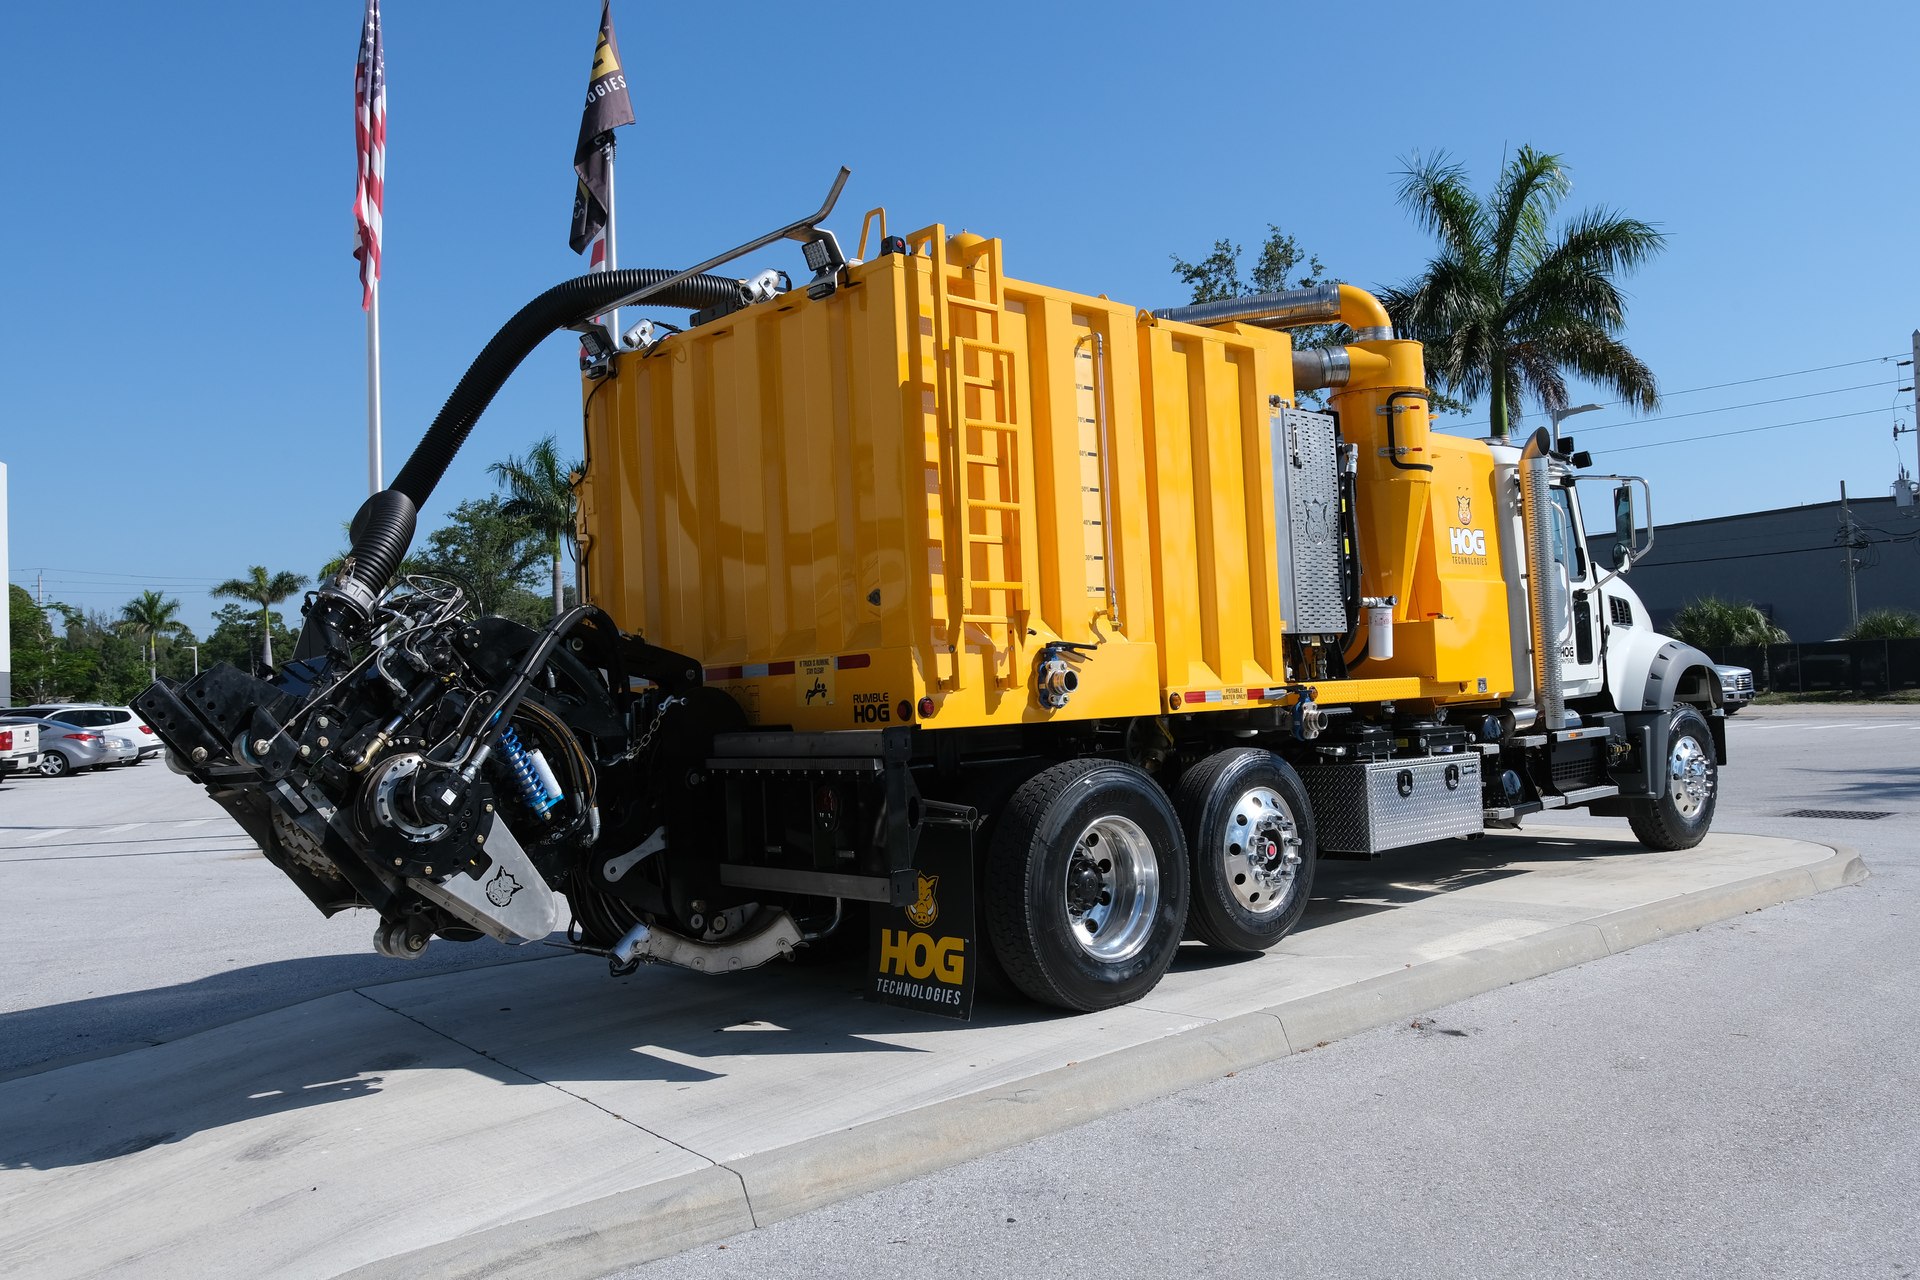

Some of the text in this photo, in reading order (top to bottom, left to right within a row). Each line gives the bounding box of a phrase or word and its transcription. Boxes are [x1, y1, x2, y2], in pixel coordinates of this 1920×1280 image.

[1449, 527, 1486, 556] HOG
[1452, 556, 1488, 566] TECHNOLOGIES
[1560, 646, 1574, 657] HOG
[853, 692, 889, 703] RUMBLE
[854, 703, 890, 723] HOG
[879, 929, 964, 985] HOG
[877, 978, 961, 1005] TECHNOLOGIES
